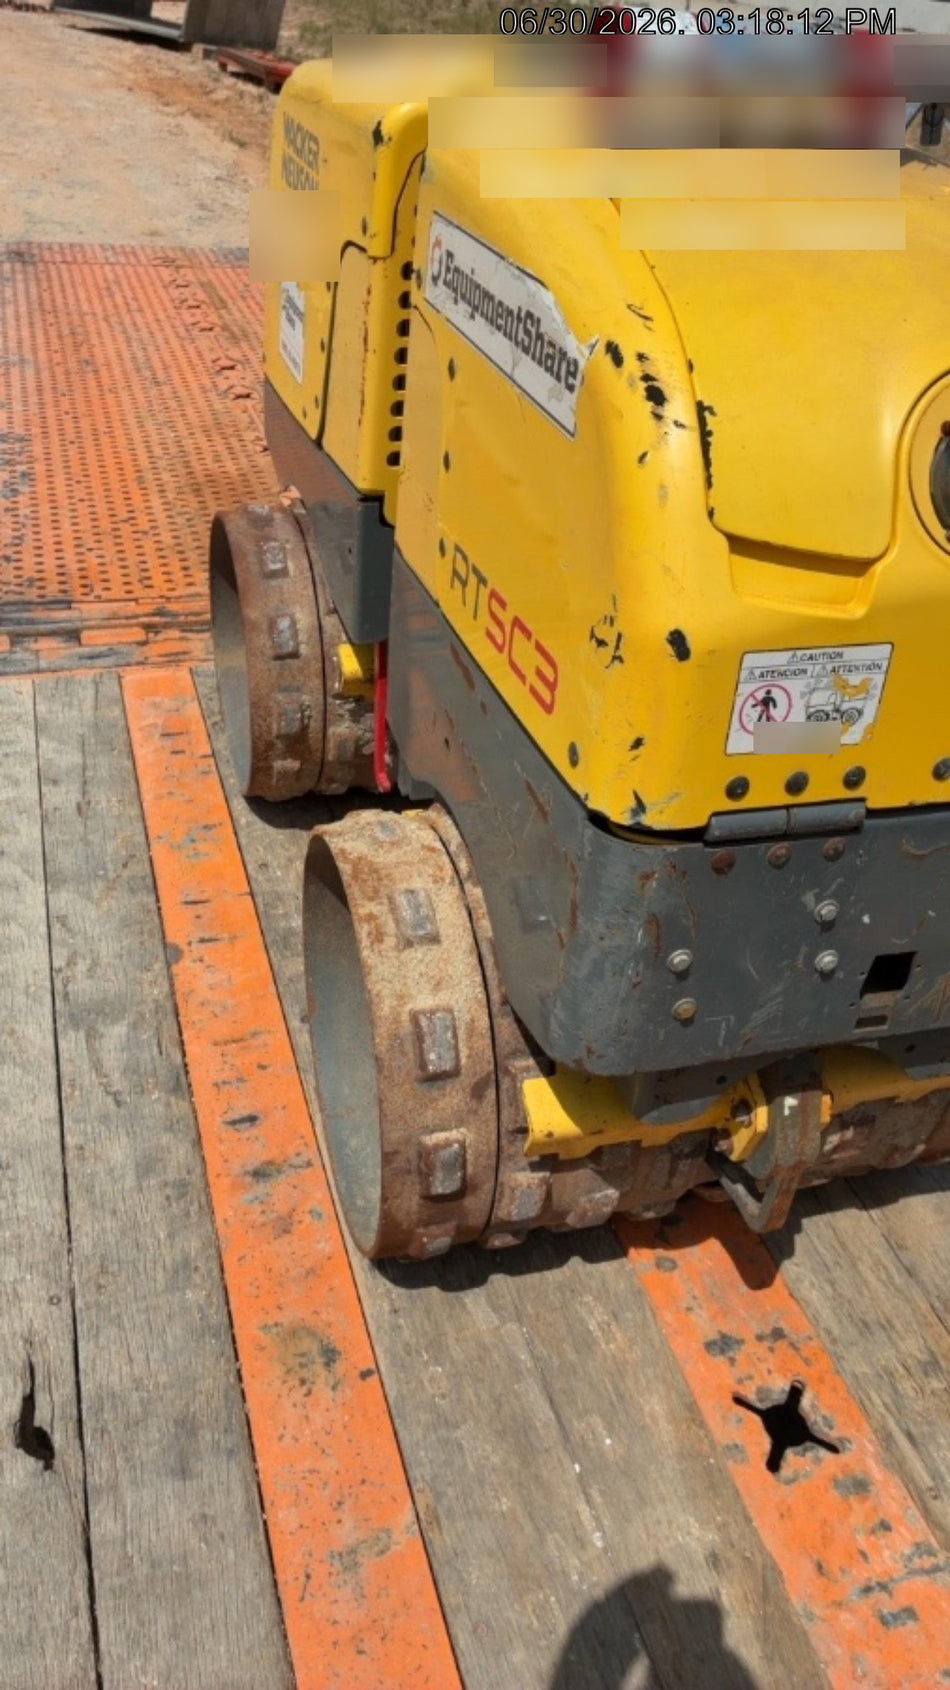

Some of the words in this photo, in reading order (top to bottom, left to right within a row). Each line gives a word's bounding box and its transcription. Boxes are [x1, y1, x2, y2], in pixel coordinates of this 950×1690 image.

[443, 249, 579, 394] EquipmentShare
[800, 651, 844, 662] CAUTION
[830, 663, 883, 674] ATTENTION
